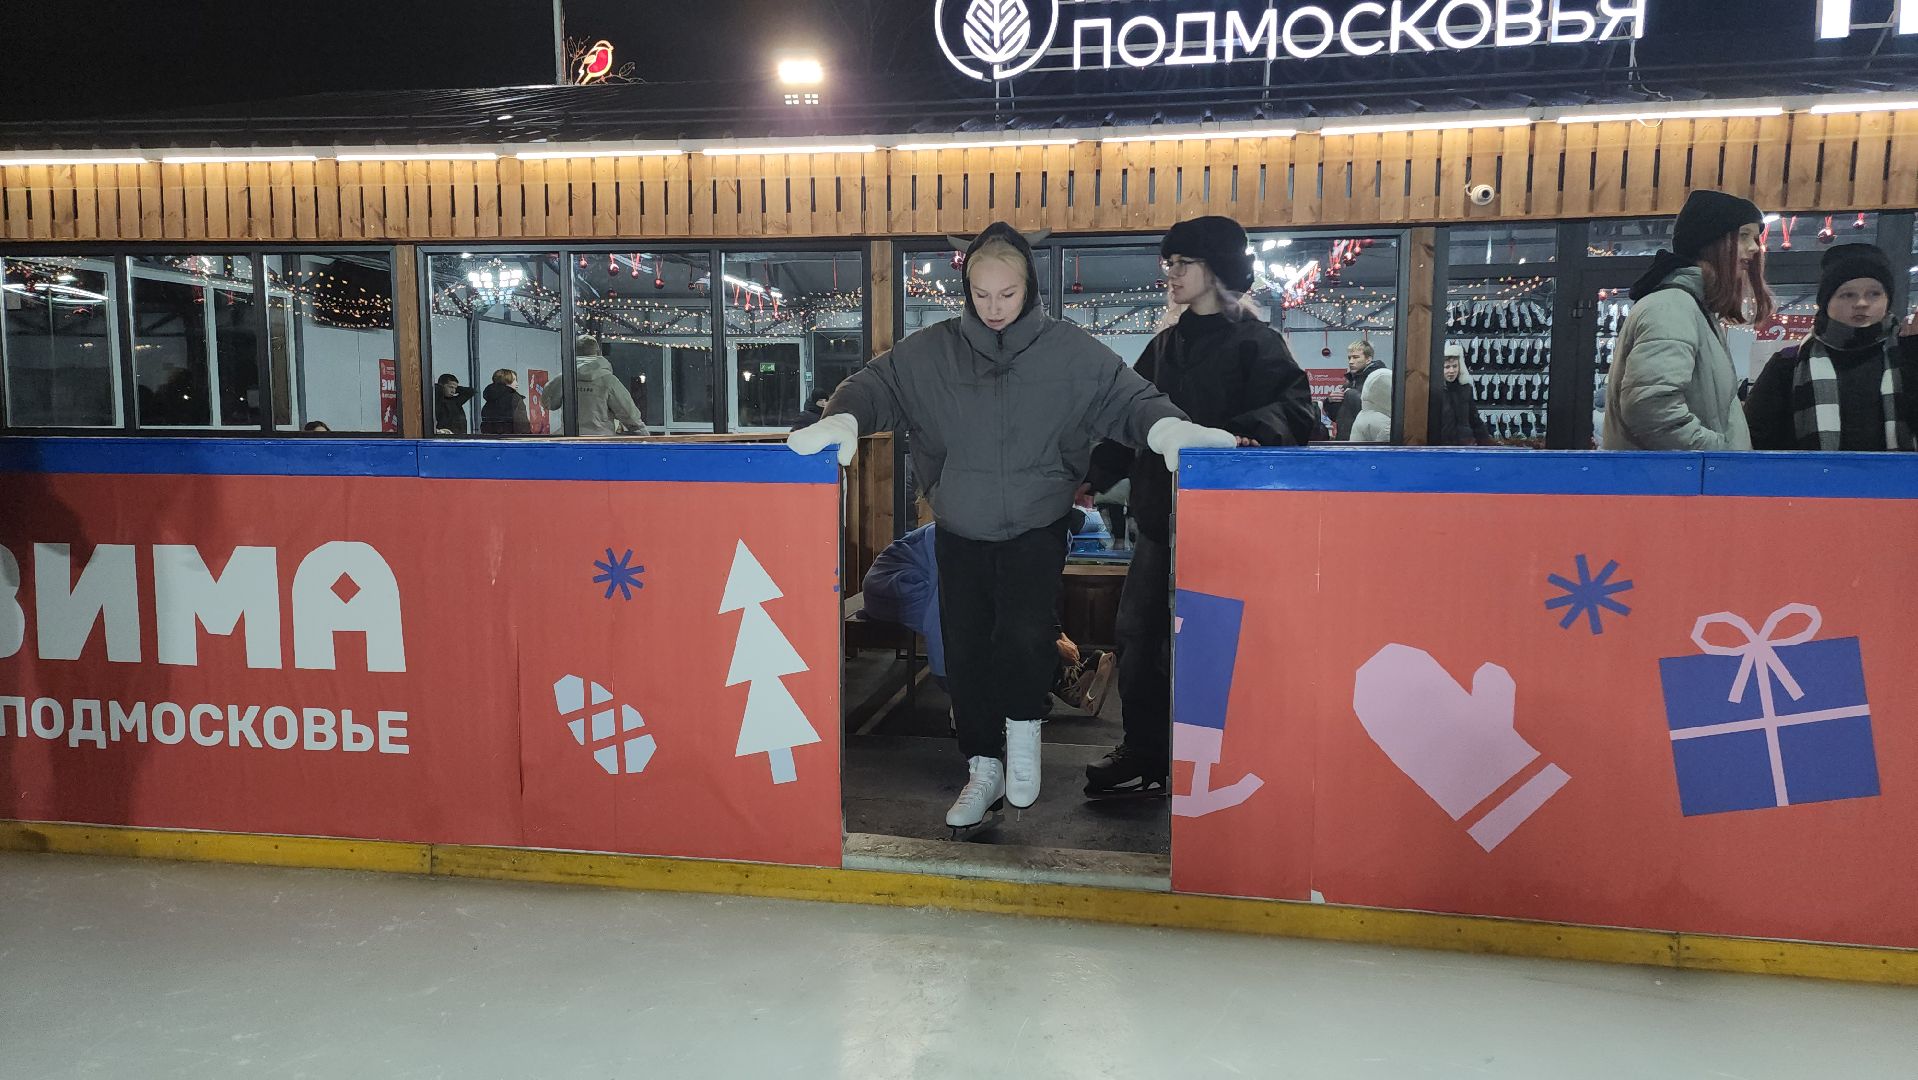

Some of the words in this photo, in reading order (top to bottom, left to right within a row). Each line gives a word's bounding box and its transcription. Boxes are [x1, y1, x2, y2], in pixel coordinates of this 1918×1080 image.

[1073, 0, 1647, 70] ПОДМОСКОВЬЯ
[0, 541, 406, 673] ИМА
[0, 696, 410, 754] ПОДМОСКОВЬЕ
